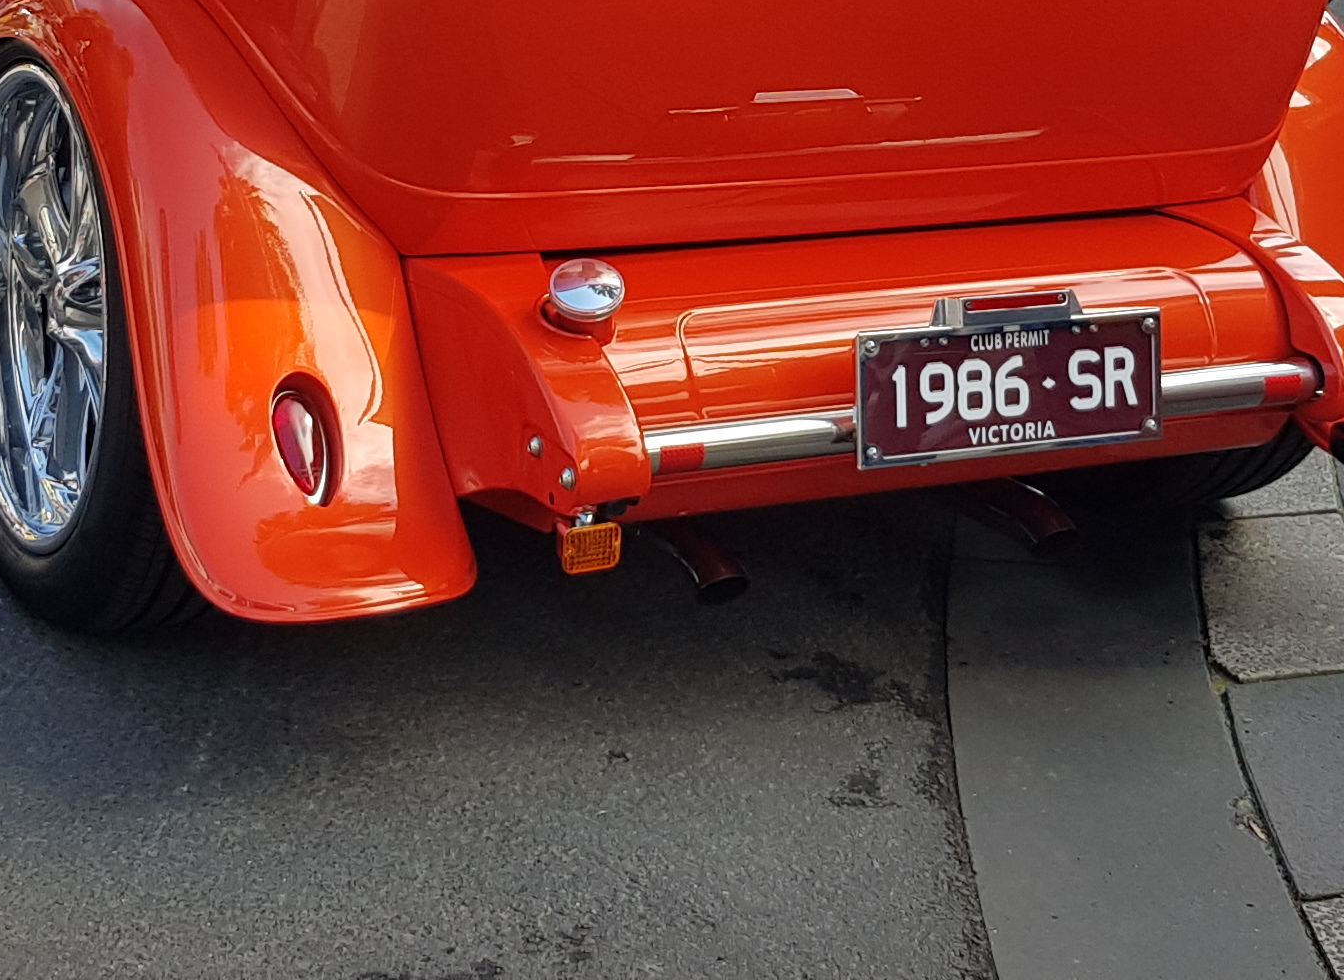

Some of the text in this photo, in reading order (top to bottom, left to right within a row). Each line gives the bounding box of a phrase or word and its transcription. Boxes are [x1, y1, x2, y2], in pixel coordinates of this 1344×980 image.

[970, 329, 1050, 352] CLUB PERMIT
[892, 346, 1139, 429] 1986 SR
[969, 420, 1056, 445] VICTORIA
